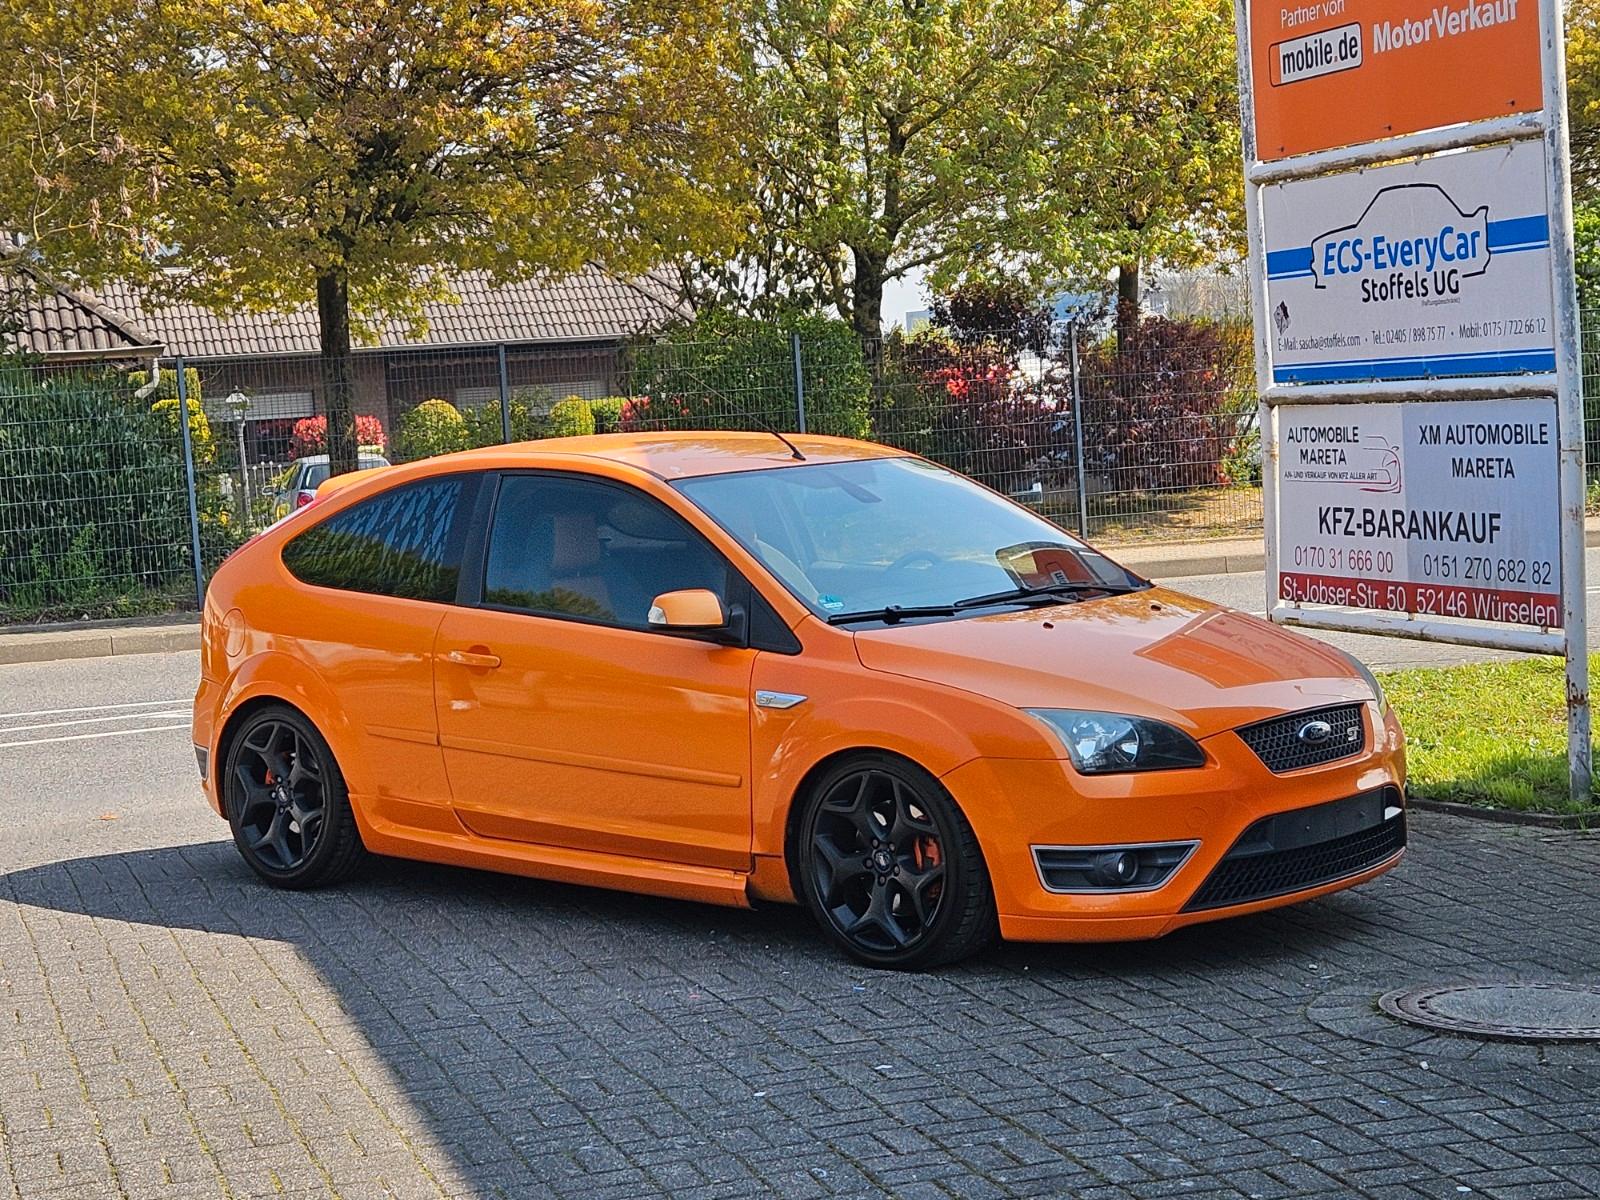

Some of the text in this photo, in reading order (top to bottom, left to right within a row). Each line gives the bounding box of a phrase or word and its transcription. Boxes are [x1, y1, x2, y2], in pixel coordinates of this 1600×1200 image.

[1281, 0, 1345, 29] Partner von
[1373, 0, 1518, 54] MotorVerkauf
[1282, 31, 1359, 75] mobile.de
[1323, 226, 1480, 276] ECS-EveryCar
[1361, 268, 1460, 303] Stoffels UG
[1299, 333, 1361, 350] sascha@stoffels.com
[1385, 328, 1407, 344] 02405
[1412, 326, 1426, 342] 898
[1427, 326, 1436, 341] 75
[1437, 325, 1446, 340] 77
[1459, 321, 1482, 339] Mobil:
[1483, 320, 1502, 337] 0175
[1509, 319, 1523, 335] 722
[1525, 318, 1535, 334] 66
[1536, 317, 1546, 333] 12
[1287, 426, 1360, 443] AUTOMOBILE
[1419, 423, 1549, 445] XM AUTOMOBILE
[1300, 448, 1347, 465] MARETA
[1452, 457, 1516, 479] MARETA
[1294, 471, 1304, 479] UND
[1304, 471, 1327, 480] VERKAUF
[1328, 471, 1338, 480] VON
[1339, 472, 1348, 480] KFZ
[1349, 472, 1366, 480] ALLER
[1366, 472, 1378, 481] ART
[1318, 506, 1501, 544] KFZ-BARANKAUF
[1294, 546, 1394, 573] 0170 31 666 00
[1423, 554, 1552, 585] 0151 270 682 82
[1282, 577, 1558, 626] St-Jobser-Str. 50 52146 Würselen
